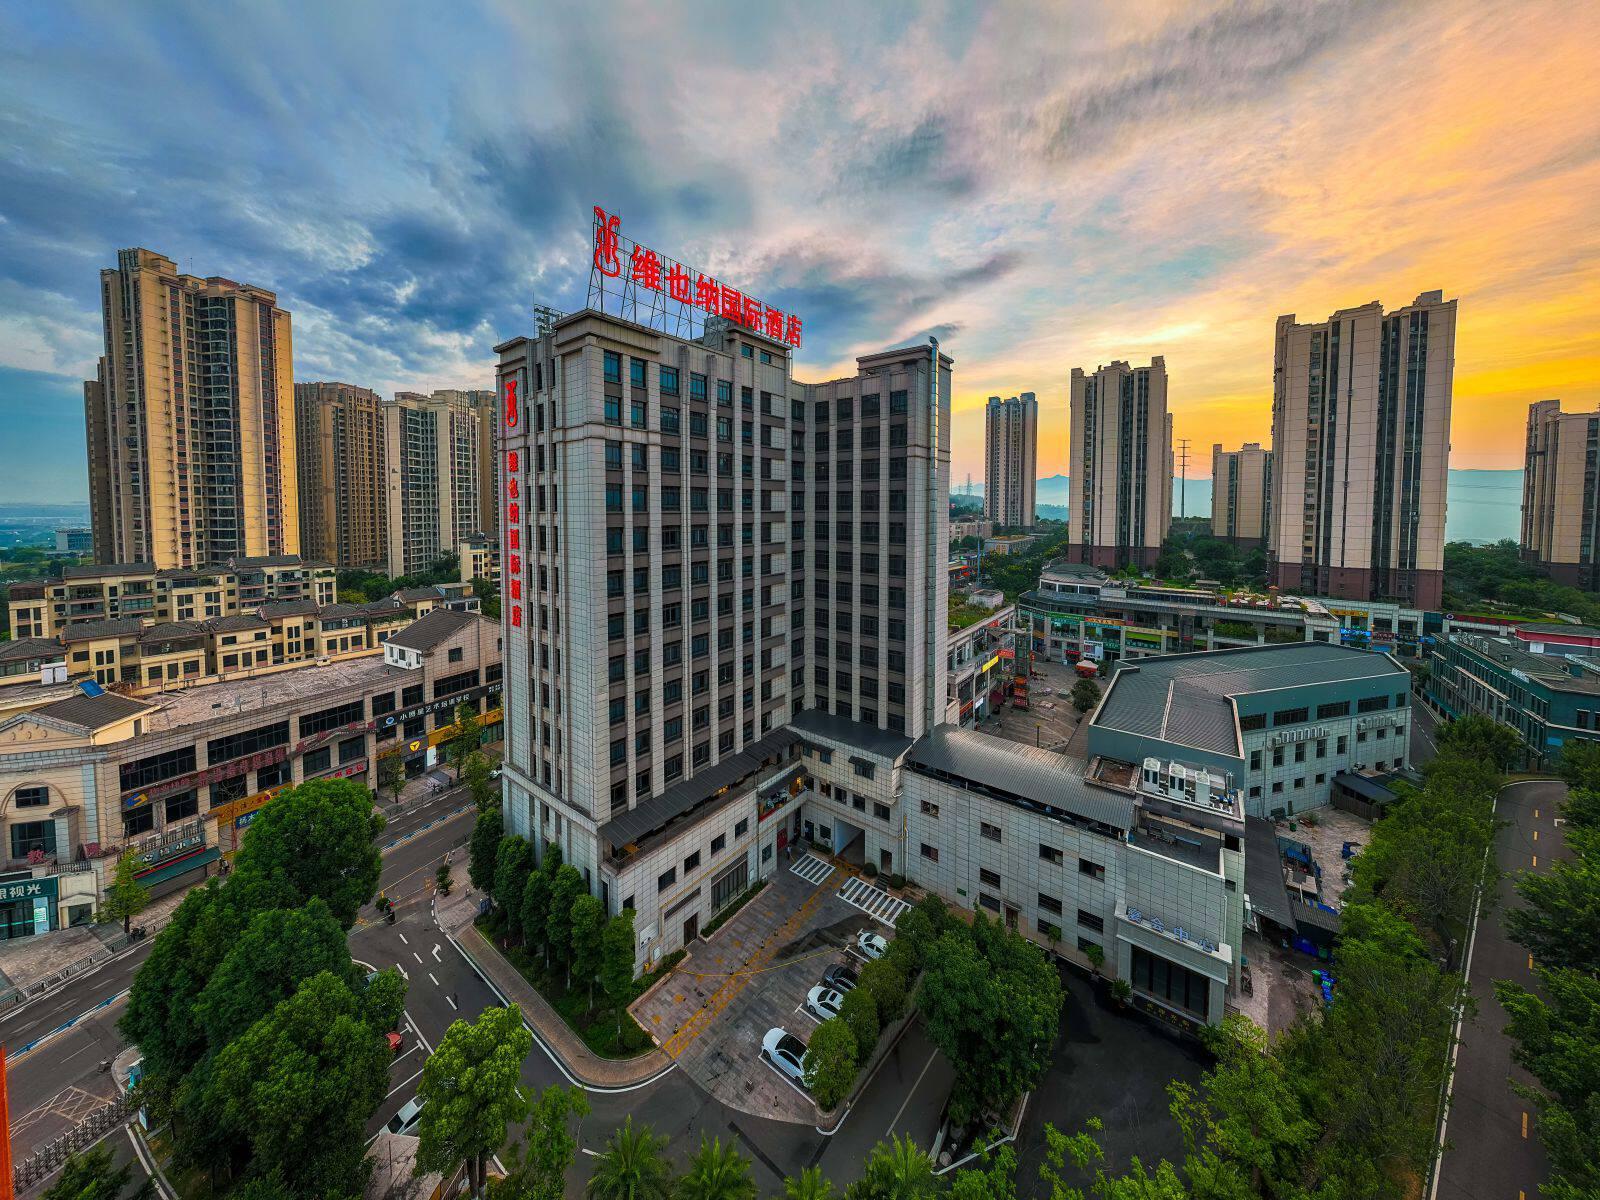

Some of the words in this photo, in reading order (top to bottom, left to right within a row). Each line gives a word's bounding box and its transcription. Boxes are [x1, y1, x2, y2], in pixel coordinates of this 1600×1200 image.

[631, 244, 803, 348] 维也纳国际酒店
